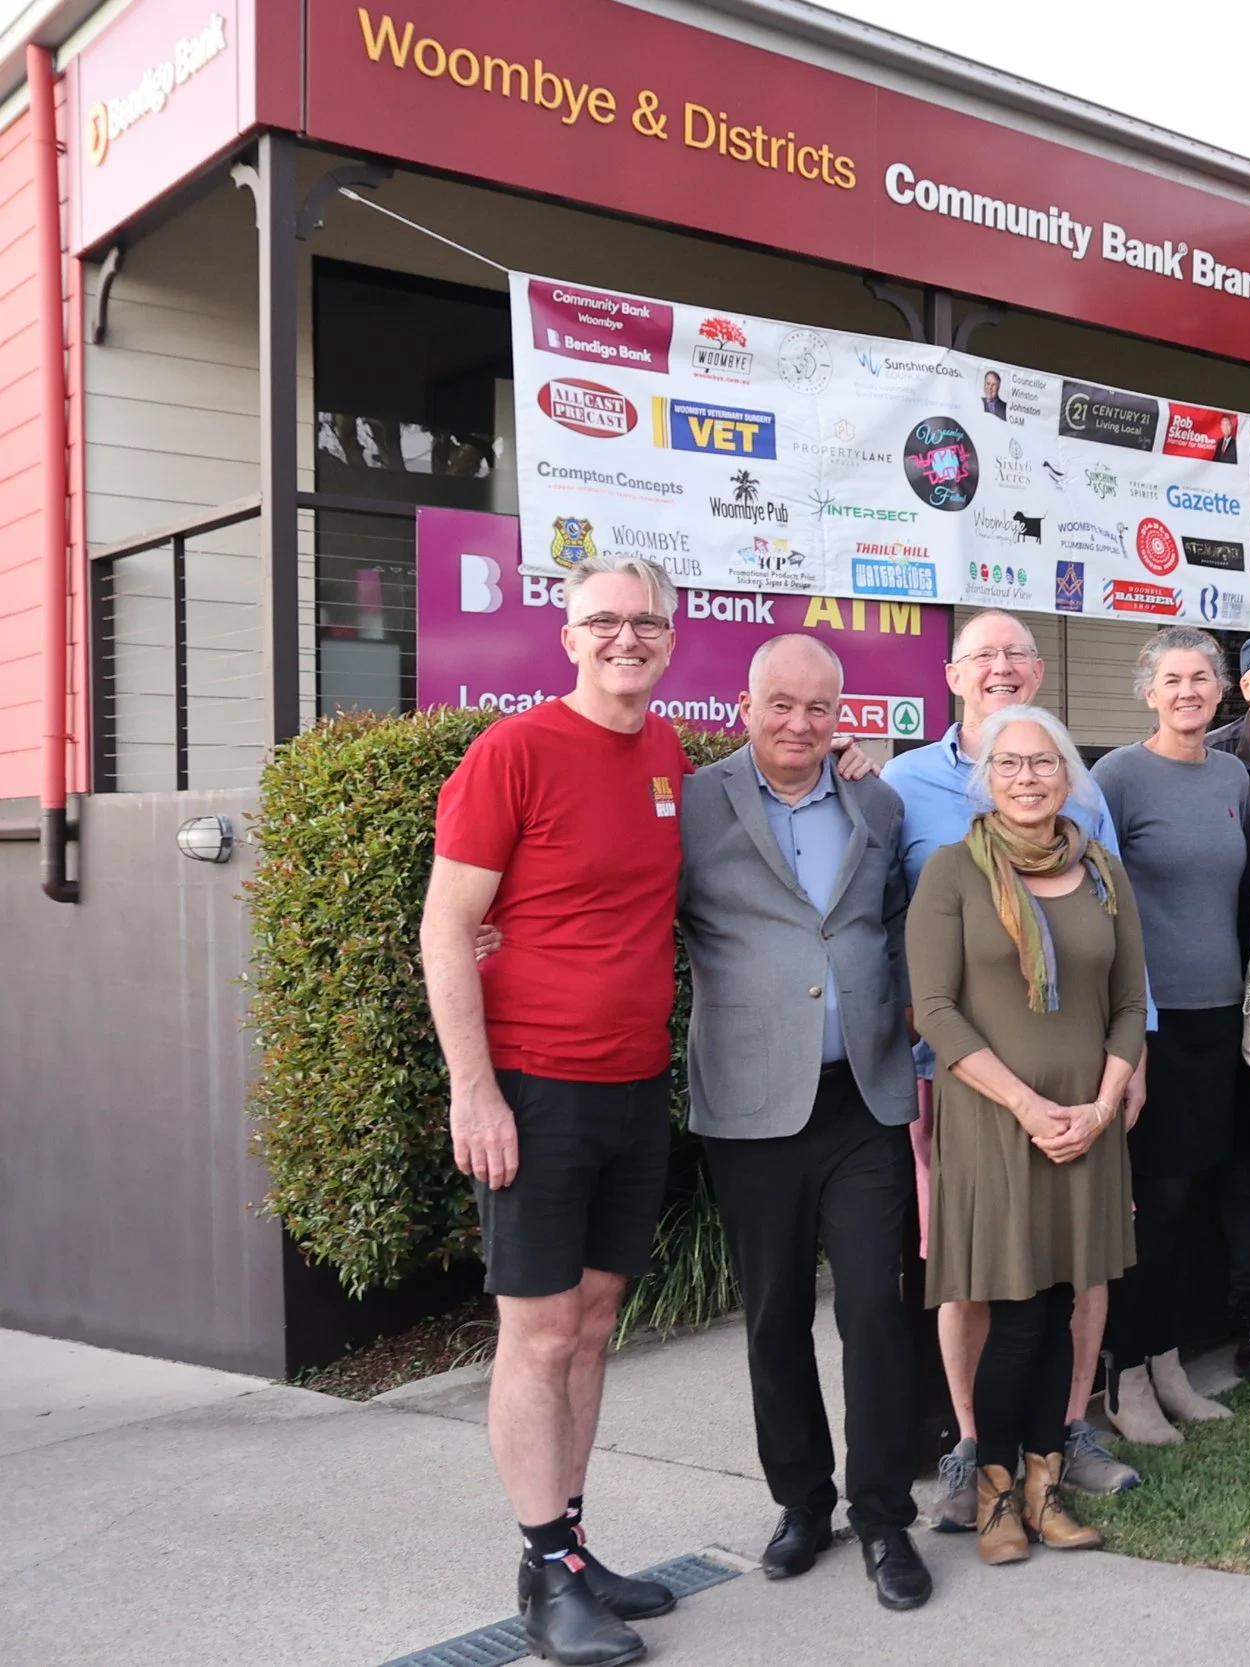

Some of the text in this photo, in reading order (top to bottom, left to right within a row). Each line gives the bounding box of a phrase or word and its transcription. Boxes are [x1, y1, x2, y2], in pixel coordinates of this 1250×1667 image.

[109, 12, 228, 141] Bendigo Bank
[357, 7, 857, 190] Woombye & Districts
[885, 163, 1092, 260] Community
[552, 289, 650, 318] Community Bank
[578, 312, 623, 331] Woombye
[564, 335, 617, 358] Bendigo
[618, 345, 652, 363] Bank
[698, 351, 747, 371] WOOMBYE
[1012, 374, 1046, 390] Councillor
[1011, 388, 1038, 401] Winston
[674, 405, 772, 424] WOOMBYE VETERINARY SURGERY
[1009, 402, 1041, 416] Johnston
[1092, 404, 1150, 425] CENTURY 21
[1009, 415, 1025, 426] OAM
[1096, 420, 1142, 435] Living Local
[1173, 414, 1193, 428] Rob
[688, 416, 759, 452] VET
[1168, 426, 1207, 442] Skelton
[537, 461, 613, 484] Crompton
[616, 472, 684, 495] Concepts
[1130, 489, 1158, 500] SPIRITS
[1166, 485, 1240, 515] Gazette
[709, 496, 788, 525] Woombye Pub
[612, 525, 690, 552] WOOMBYE
[856, 542, 930, 558] THRILL HILL
[662, 556, 702, 576] CLUB
[729, 568, 769, 578] Promotional
[855, 564, 932, 590] WATERSLIDES
[687, 590, 776, 624] Bank
[1114, 592, 1175, 605] BARBER
